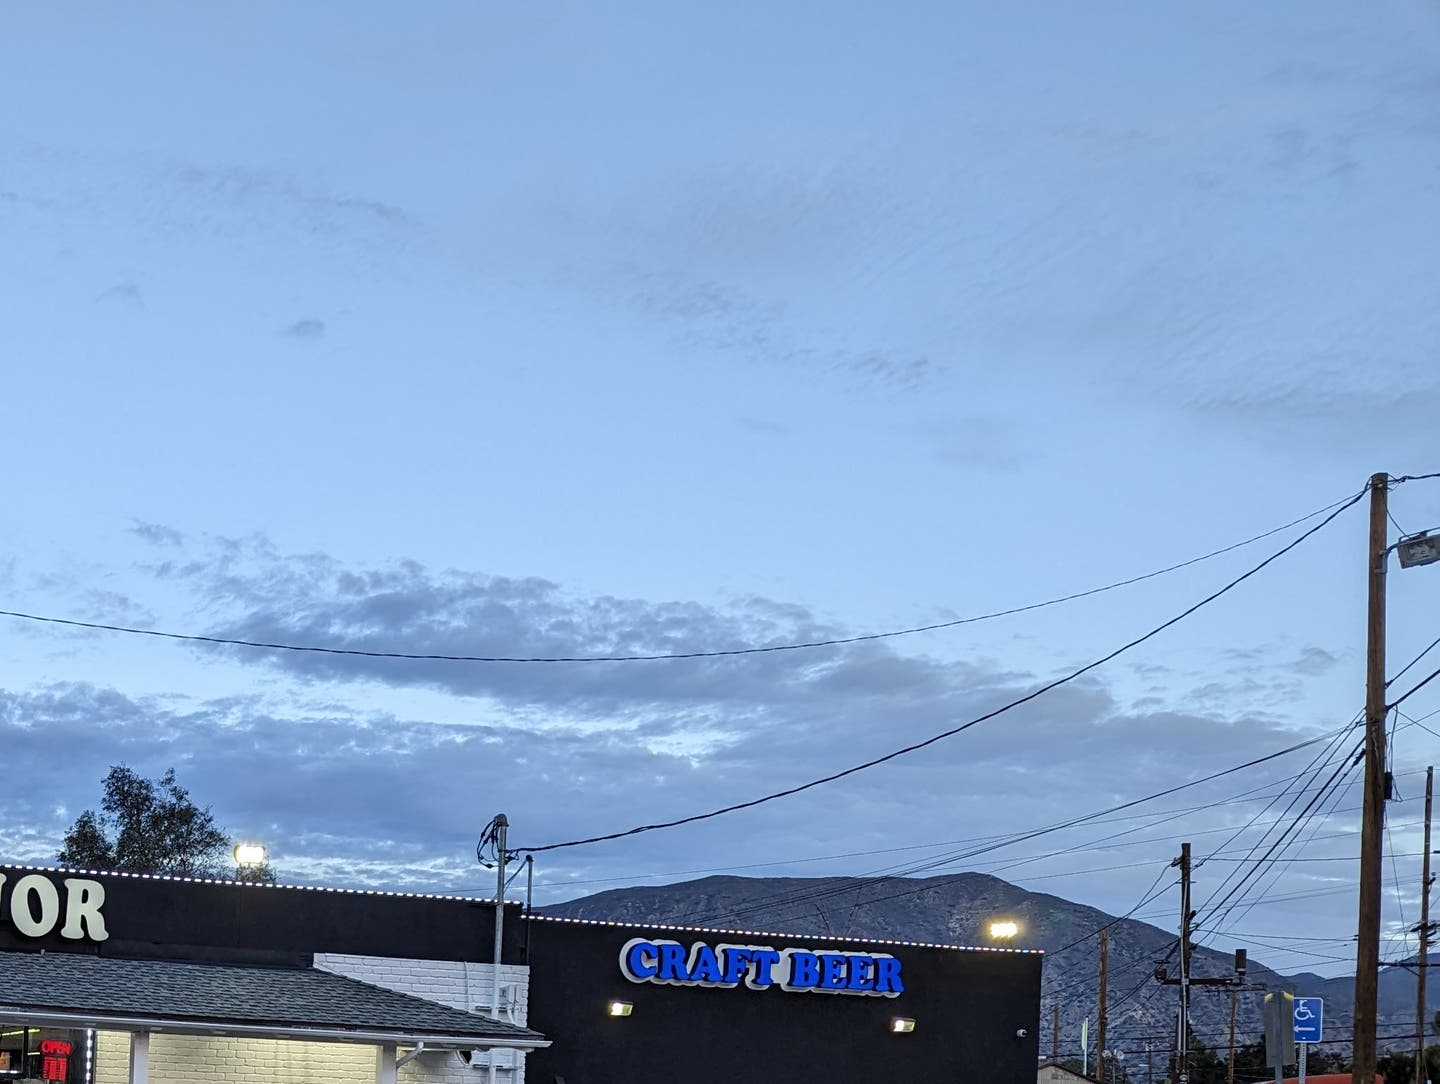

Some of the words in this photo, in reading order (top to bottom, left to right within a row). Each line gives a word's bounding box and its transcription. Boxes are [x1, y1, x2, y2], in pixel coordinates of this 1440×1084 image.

[625, 940, 780, 988] CRAFT
[788, 950, 905, 994] BEER
[42, 1040, 72, 1055] OPEN
